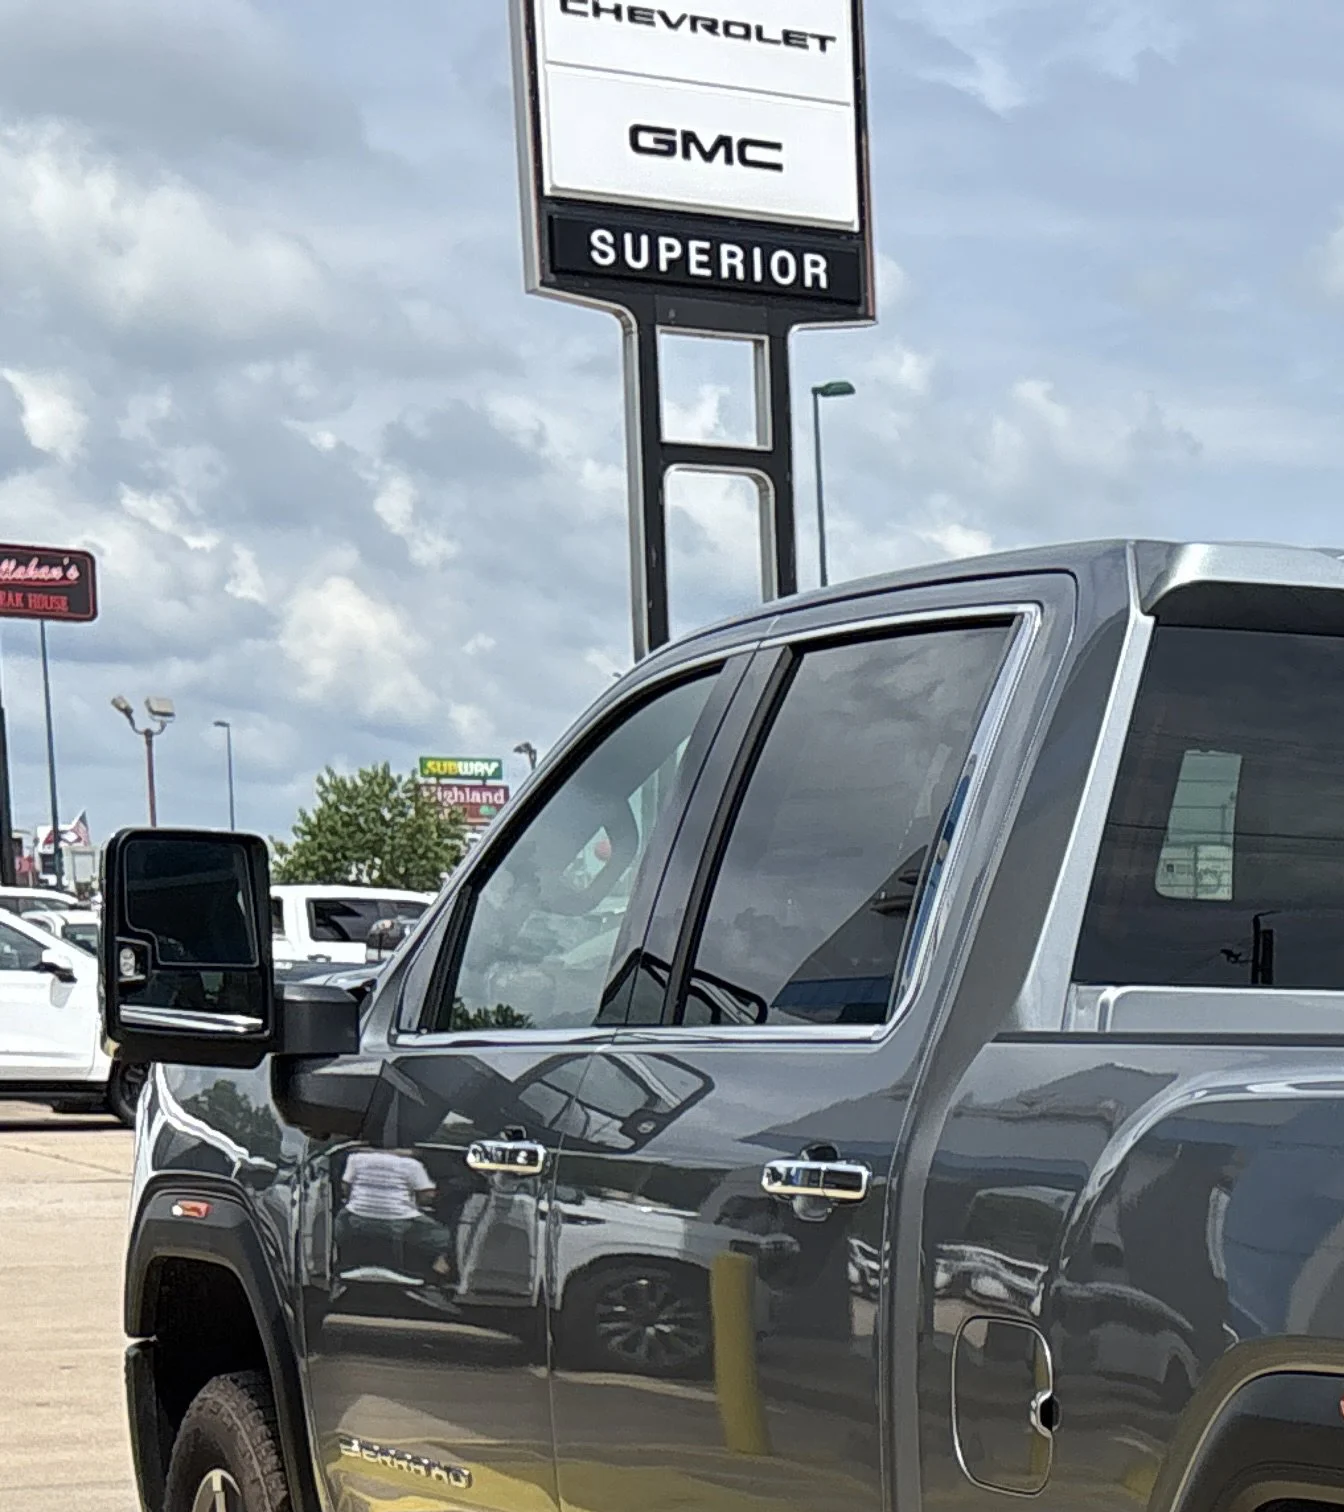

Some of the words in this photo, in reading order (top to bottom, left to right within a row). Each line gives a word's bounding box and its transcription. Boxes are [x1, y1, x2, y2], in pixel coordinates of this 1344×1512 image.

[559, 0, 837, 53] CHEVROLET
[629, 123, 783, 172] GMC
[590, 229, 828, 289] SUPERIOR
[28, 591, 69, 613] HOUSE
[423, 760, 499, 777] SUBWAY
